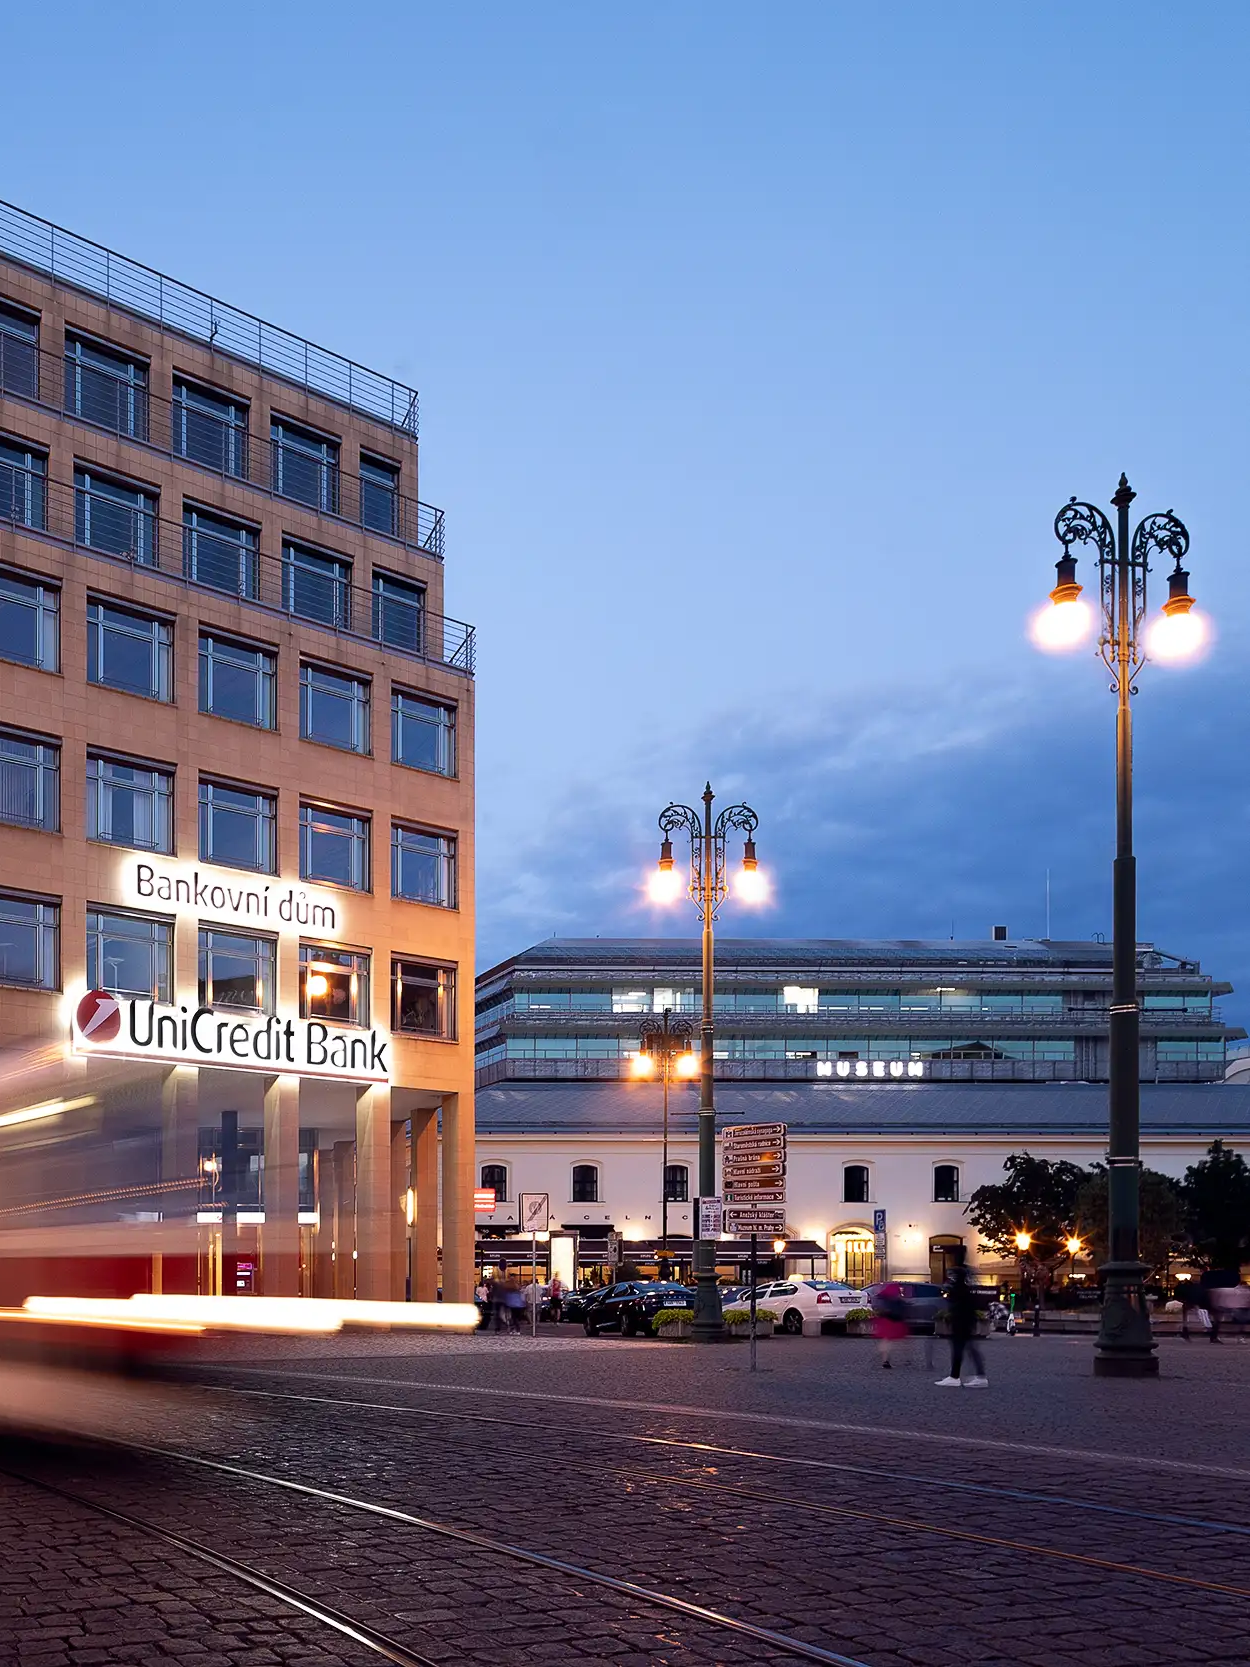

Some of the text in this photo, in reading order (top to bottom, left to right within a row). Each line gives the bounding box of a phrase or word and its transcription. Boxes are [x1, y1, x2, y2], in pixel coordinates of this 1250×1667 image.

[137, 863, 336, 929] Bankovní dům
[128, 998, 388, 1073] UniCredit Bank
[816, 1061, 923, 1077] MUSEUM
[876, 1212, 883, 1226] P
